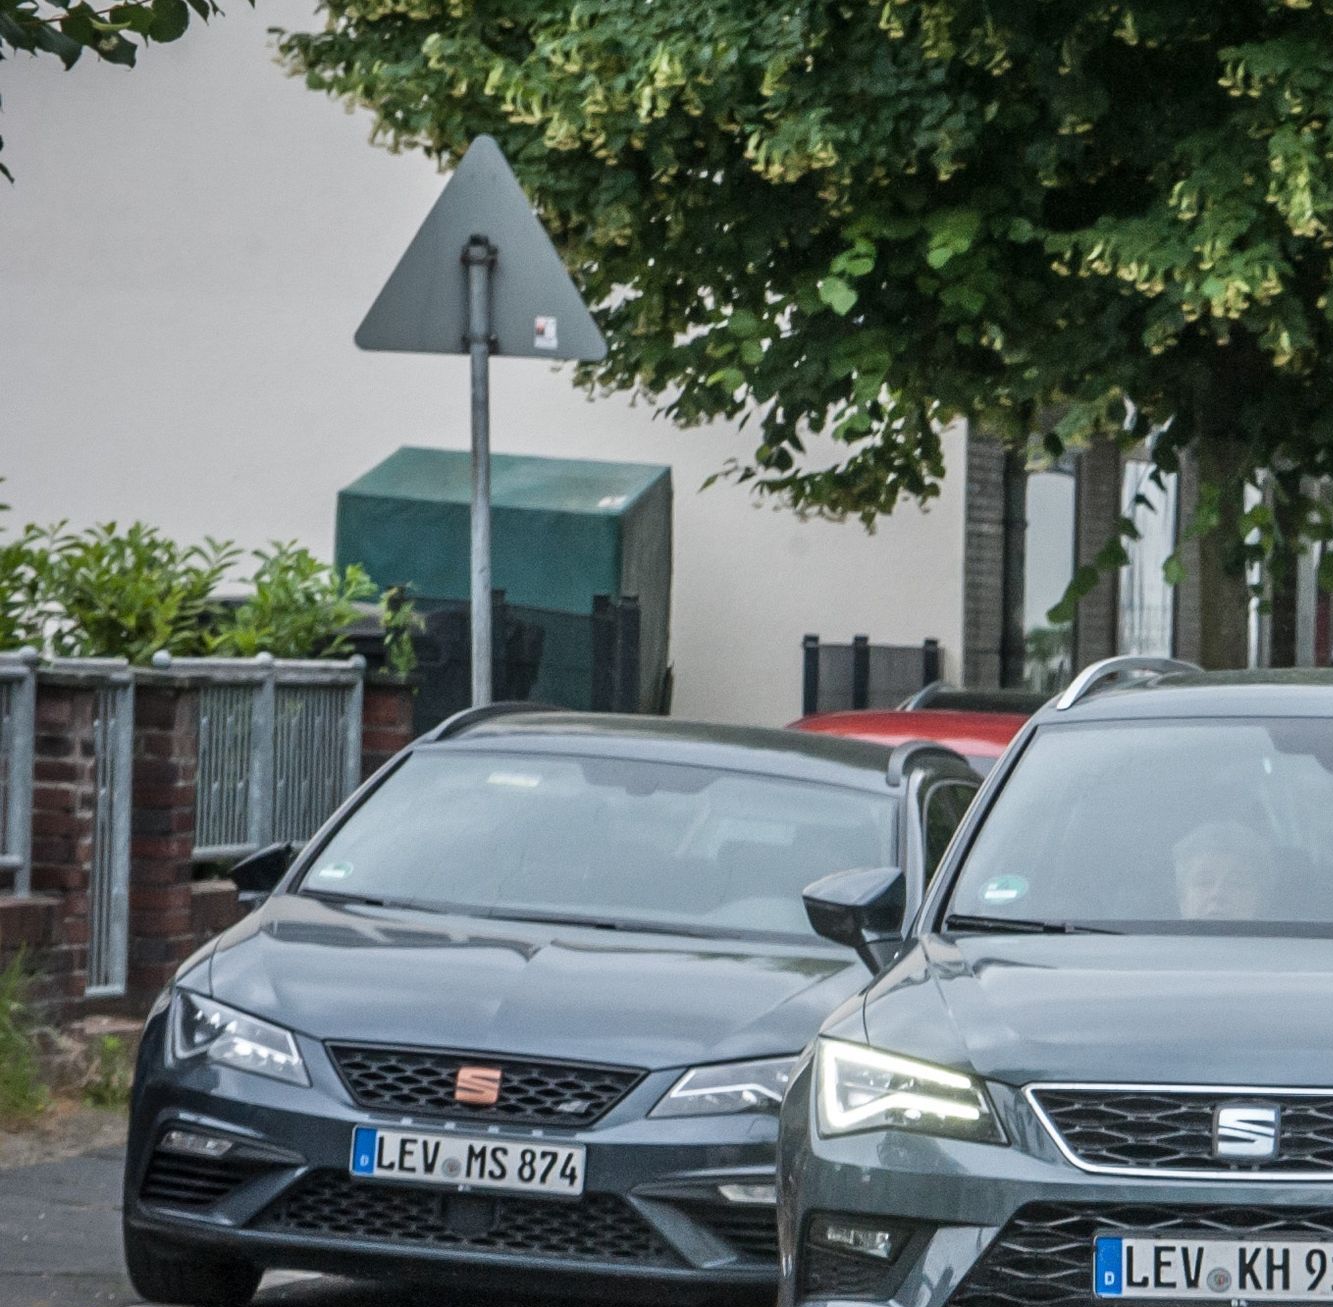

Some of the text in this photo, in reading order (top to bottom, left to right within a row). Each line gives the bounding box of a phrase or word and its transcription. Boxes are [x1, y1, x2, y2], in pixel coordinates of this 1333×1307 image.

[376, 1136, 441, 1174] LEV
[465, 1143, 509, 1181] MS
[518, 1148, 578, 1187] 874
[1104, 1270, 1115, 1285] D
[1126, 1246, 1205, 1289] LEV
[1238, 1247, 1290, 1291] KH
